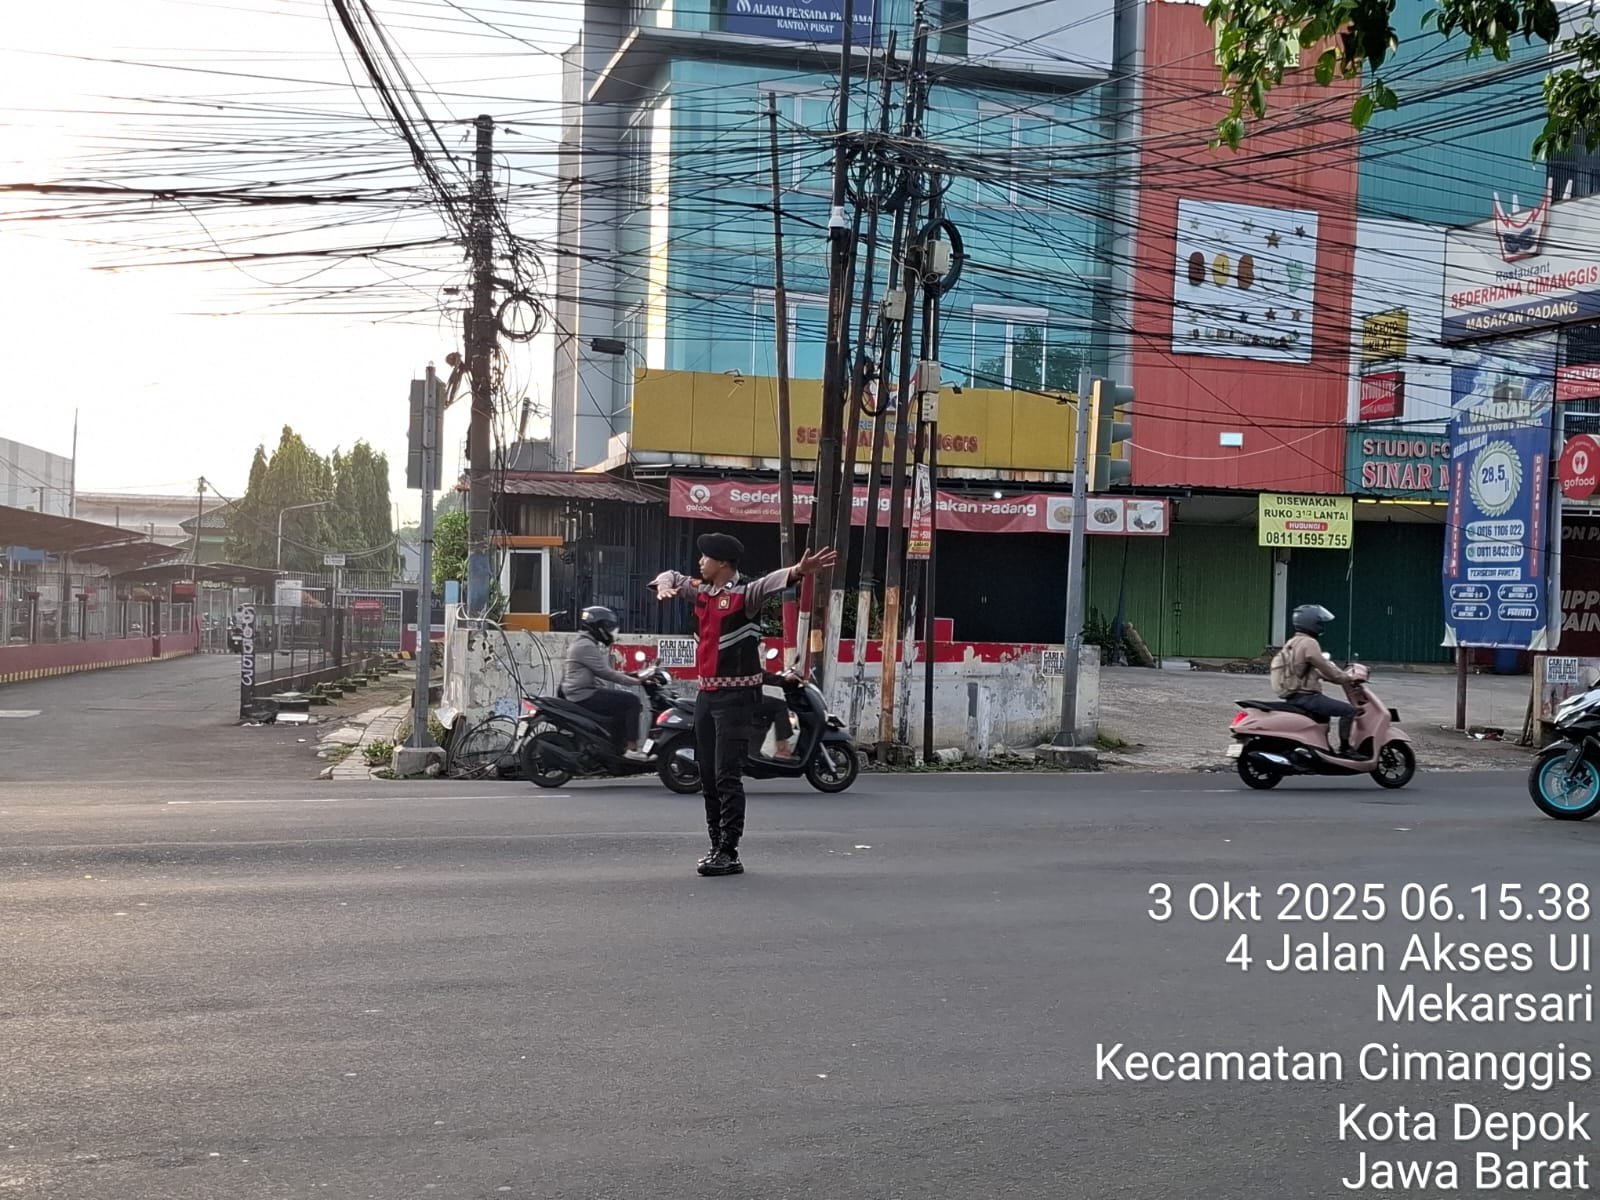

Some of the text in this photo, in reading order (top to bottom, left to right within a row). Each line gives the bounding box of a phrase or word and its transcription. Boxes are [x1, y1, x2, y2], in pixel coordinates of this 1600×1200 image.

[810, 22, 834, 33] PUSAT
[1451, 265, 1598, 308] SEDERHANA CIMANGGIS
[1466, 300, 1578, 331] MASAKAN PADANG
[1363, 438, 1427, 458] STUDIO
[1362, 461, 1432, 490] SINAR
[1482, 464, 1505, 484] 28,5
[1564, 475, 1595, 490] gofood
[1276, 496, 1336, 507] DISEWAKAN
[982, 504, 1036, 516] Padang
[1264, 509, 1293, 518] RUKO
[1313, 511, 1348, 520] LANTAI
[1266, 531, 1348, 547] 0811 1595 755
[660, 640, 694, 648] CARI ALAT
